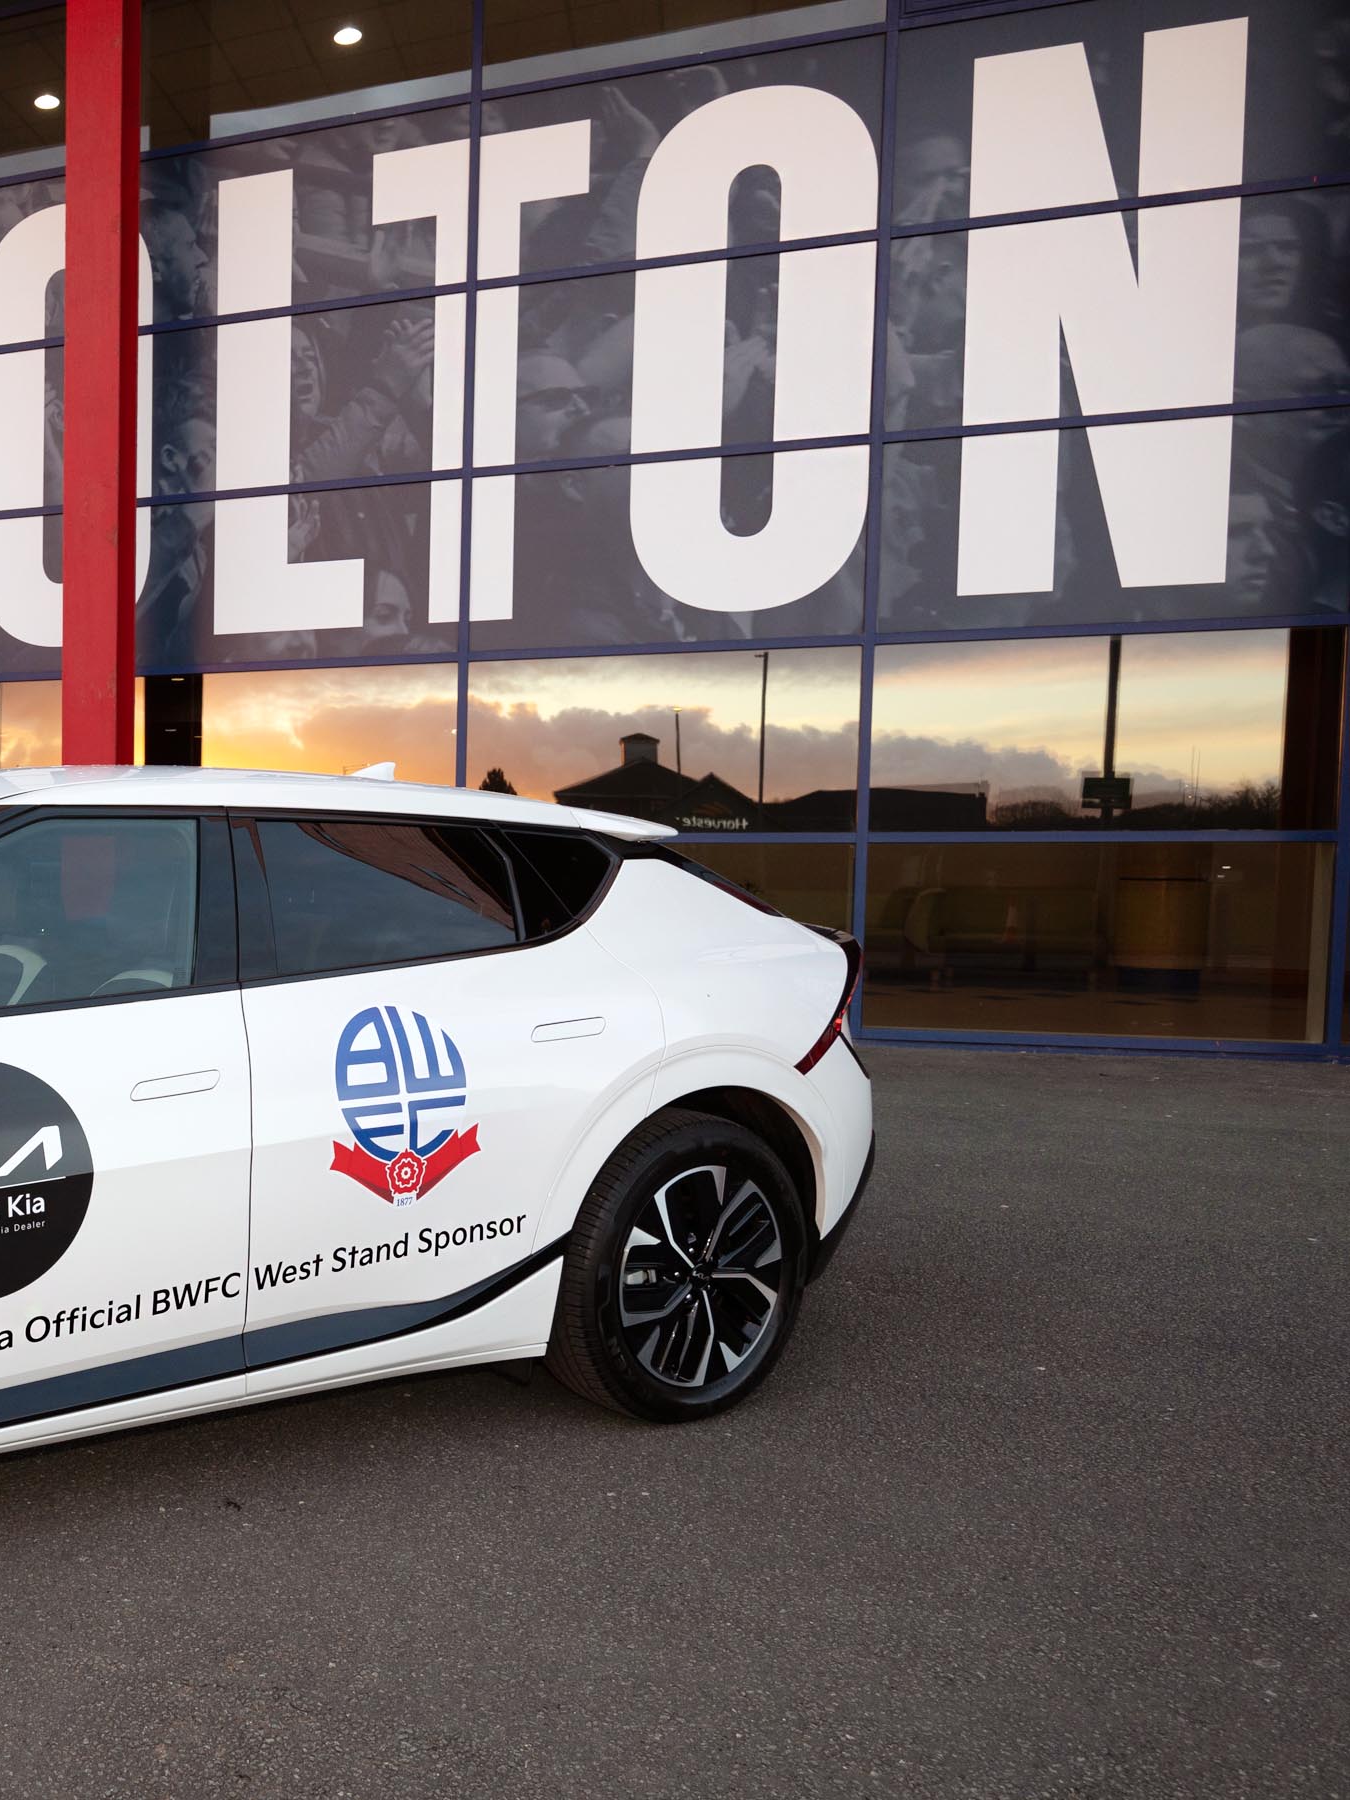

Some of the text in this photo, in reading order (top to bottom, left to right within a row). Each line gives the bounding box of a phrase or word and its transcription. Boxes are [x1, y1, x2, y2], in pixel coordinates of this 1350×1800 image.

[8, 1193, 46, 1218] Kia
[396, 1197, 413, 1207] 1877
[13, 1219, 46, 1232] Dealer
[25, 1294, 141, 1343] Official
[151, 1272, 242, 1316] BWFC
[254, 1253, 323, 1291] West
[331, 1232, 410, 1273] Stand
[417, 1214, 527, 1257] Sponsor
